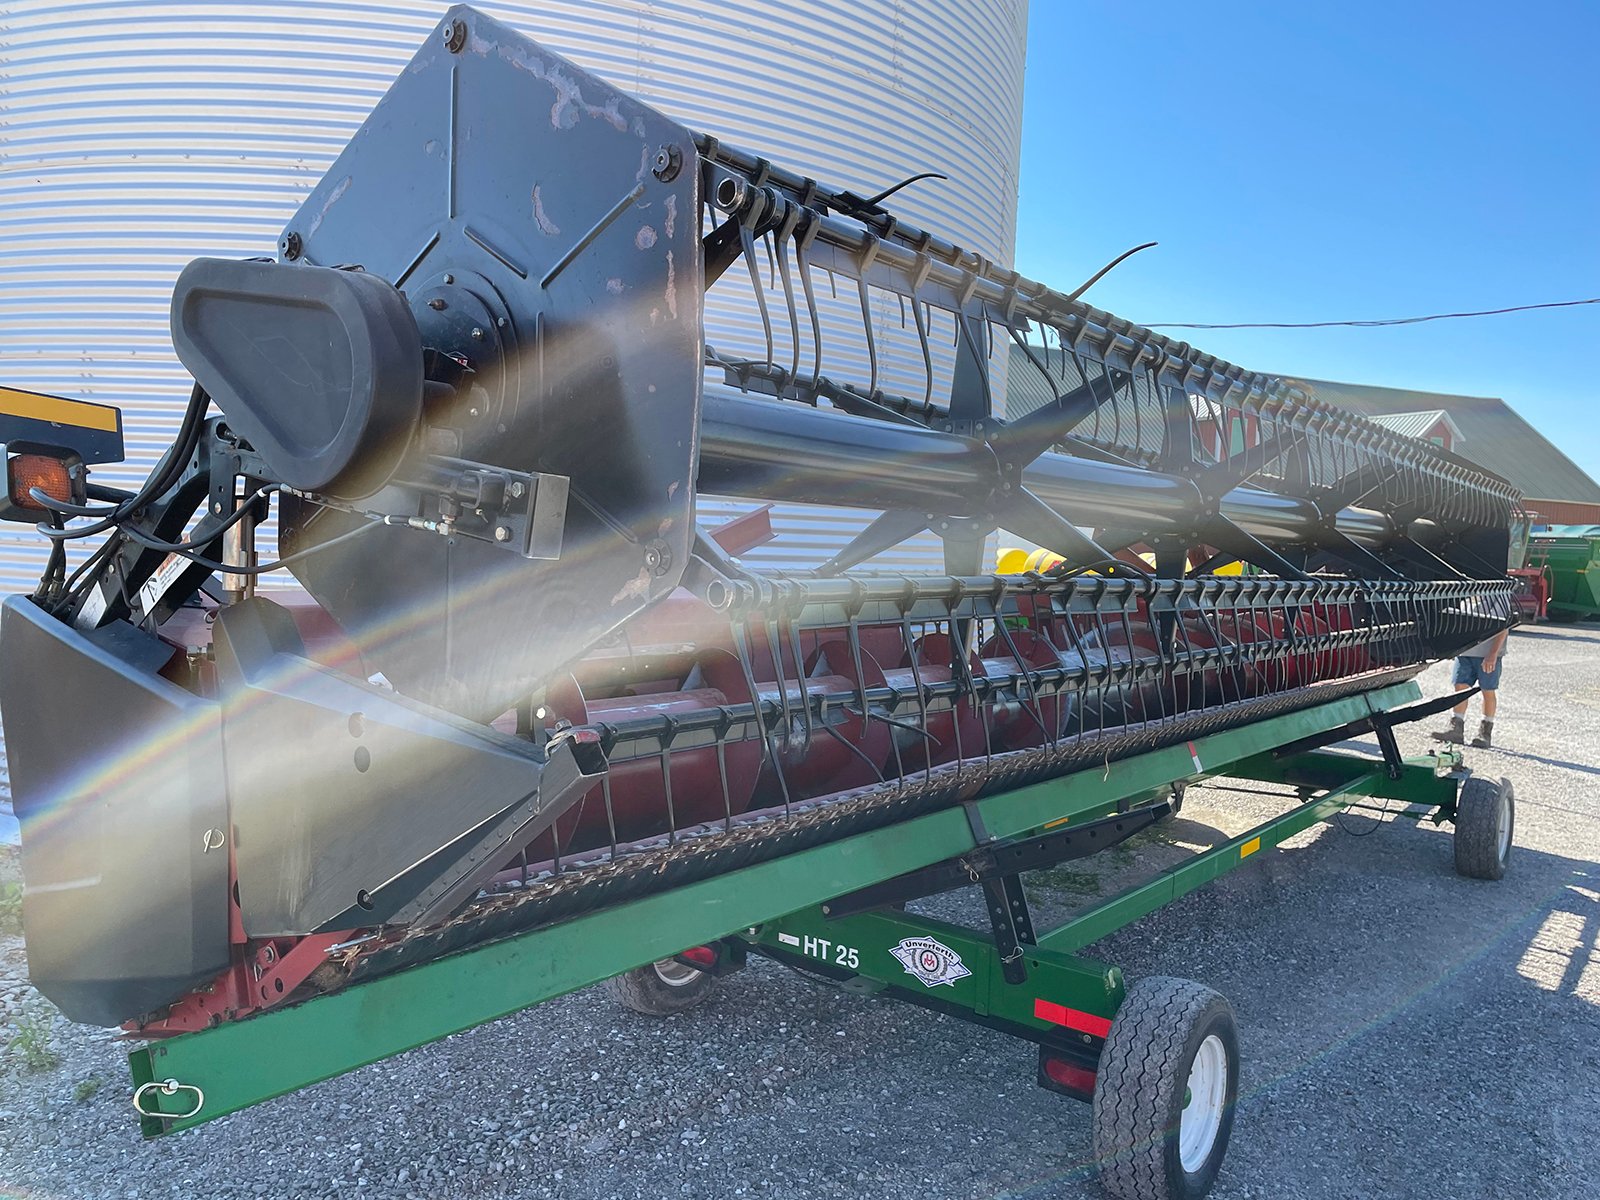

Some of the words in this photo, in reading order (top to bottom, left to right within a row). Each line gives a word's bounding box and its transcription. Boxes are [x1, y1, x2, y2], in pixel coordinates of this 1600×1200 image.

[804, 935, 831, 960] HT
[835, 944, 859, 969] 25
[905, 941, 954, 960] Unverferth
